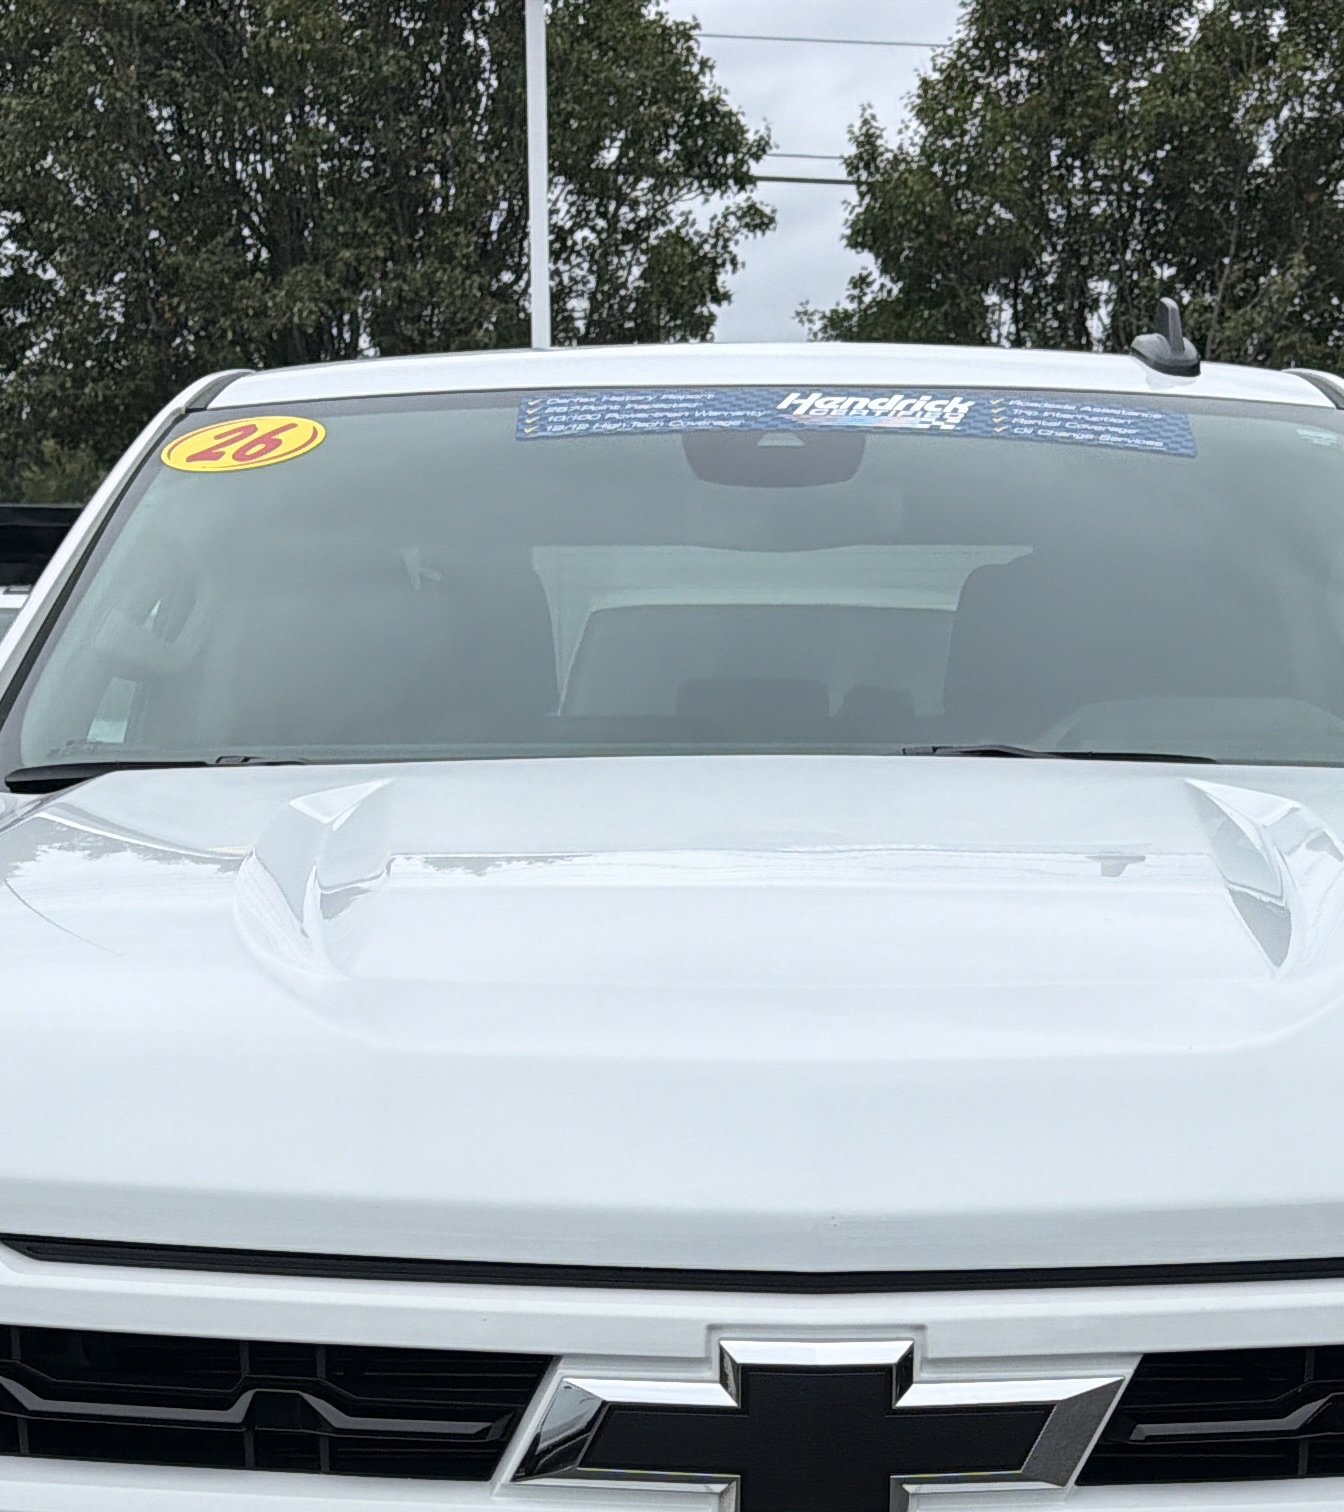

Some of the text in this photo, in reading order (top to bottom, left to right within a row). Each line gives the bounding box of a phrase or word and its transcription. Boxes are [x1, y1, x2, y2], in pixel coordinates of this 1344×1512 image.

[776, 392, 976, 416] Hendrick
[1080, 405, 1165, 419] Assistance
[605, 410, 690, 420] Powertrain
[693, 408, 770, 418] Warranty
[809, 408, 965, 424] CERTIFIED
[1012, 408, 1133, 425] Trip Interruption
[668, 418, 744, 429] Coverage
[1011, 417, 1140, 434] Rental Coverage
[185, 422, 299, 463] 26
[1013, 426, 1165, 447] Oil Change Services
